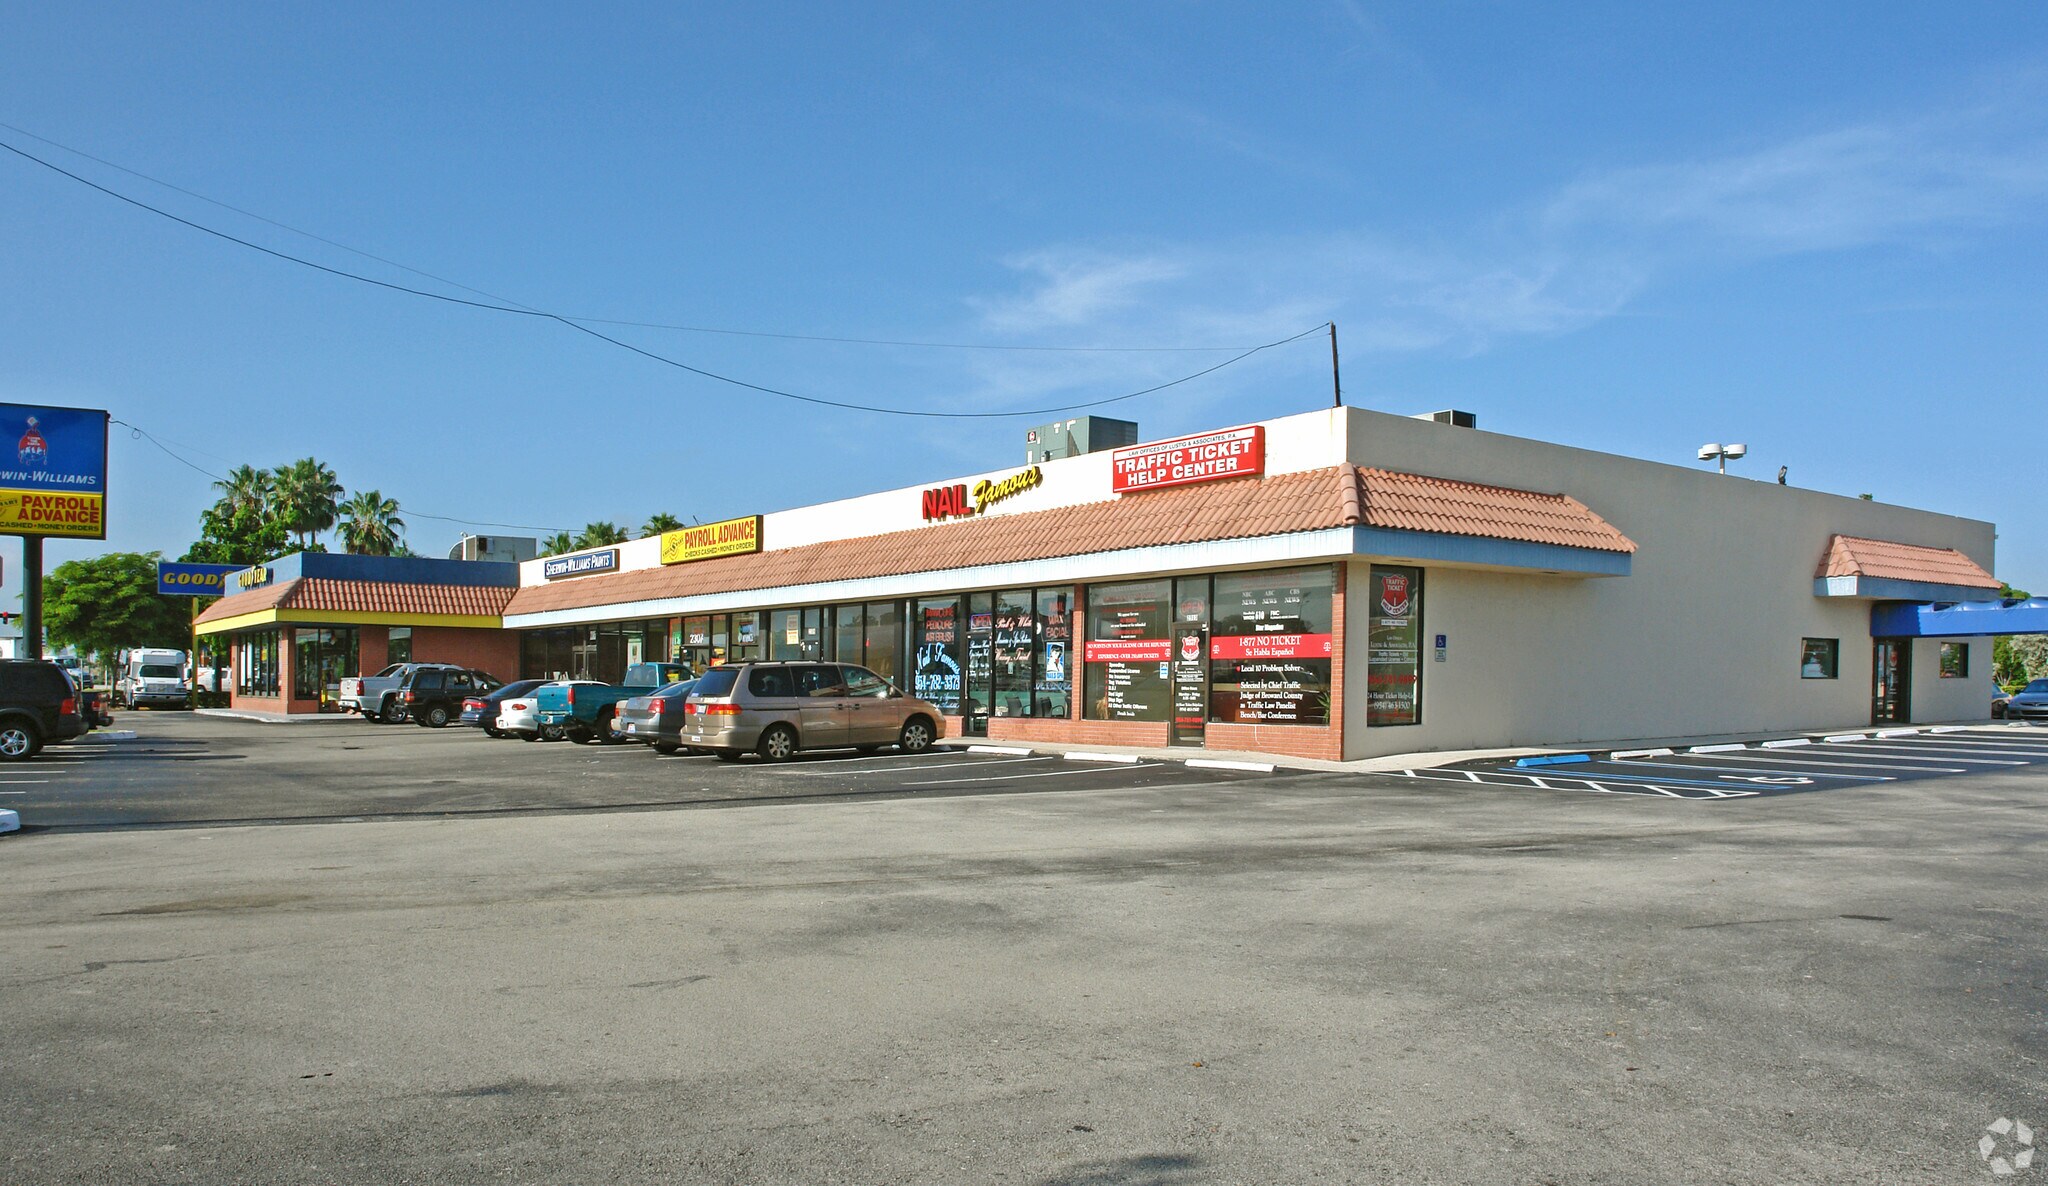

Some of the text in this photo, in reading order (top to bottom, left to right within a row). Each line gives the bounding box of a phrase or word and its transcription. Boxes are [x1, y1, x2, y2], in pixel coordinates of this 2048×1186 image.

[1128, 449, 1139, 457] LAW
[1139, 446, 1160, 455] OFFICES
[1169, 441, 1187, 450] LUSTIG
[1193, 433, 1227, 445] ASSOCIATES,
[1116, 438, 1253, 474] TRAFFIC TICKET
[1127, 457, 1238, 486] HELP CENTER
[922, 466, 1039, 520] NAIL Famous
[21, 495, 99, 511] PAYROLL
[18, 508, 99, 523] ADVANCE
[684, 527, 717, 549] PAYROLL
[718, 519, 755, 544] ADVANCE
[684, 541, 755, 558] CHECKS CASHED MONEY ORDERS
[1385, 578, 1405, 586] TRAFFIC
[1256, 636, 1270, 646] NO
[1271, 635, 1302, 646] TICKET
[1245, 647, 1294, 657] Se Habla Español
[1241, 664, 1254, 672] Local
[1255, 664, 1262, 672] 10
[1262, 664, 1283, 672] Problem
[1240, 681, 1260, 689] Selected
[1268, 681, 1283, 689] Chief
[1283, 681, 1301, 689] Traffic
[1240, 692, 1254, 700] Judge
[1261, 691, 1283, 699] Broward
[1284, 692, 1303, 700] County
[1264, 701, 1275, 709] Law
[1275, 701, 1296, 709] Panelist
[1267, 711, 1296, 719] Conference
